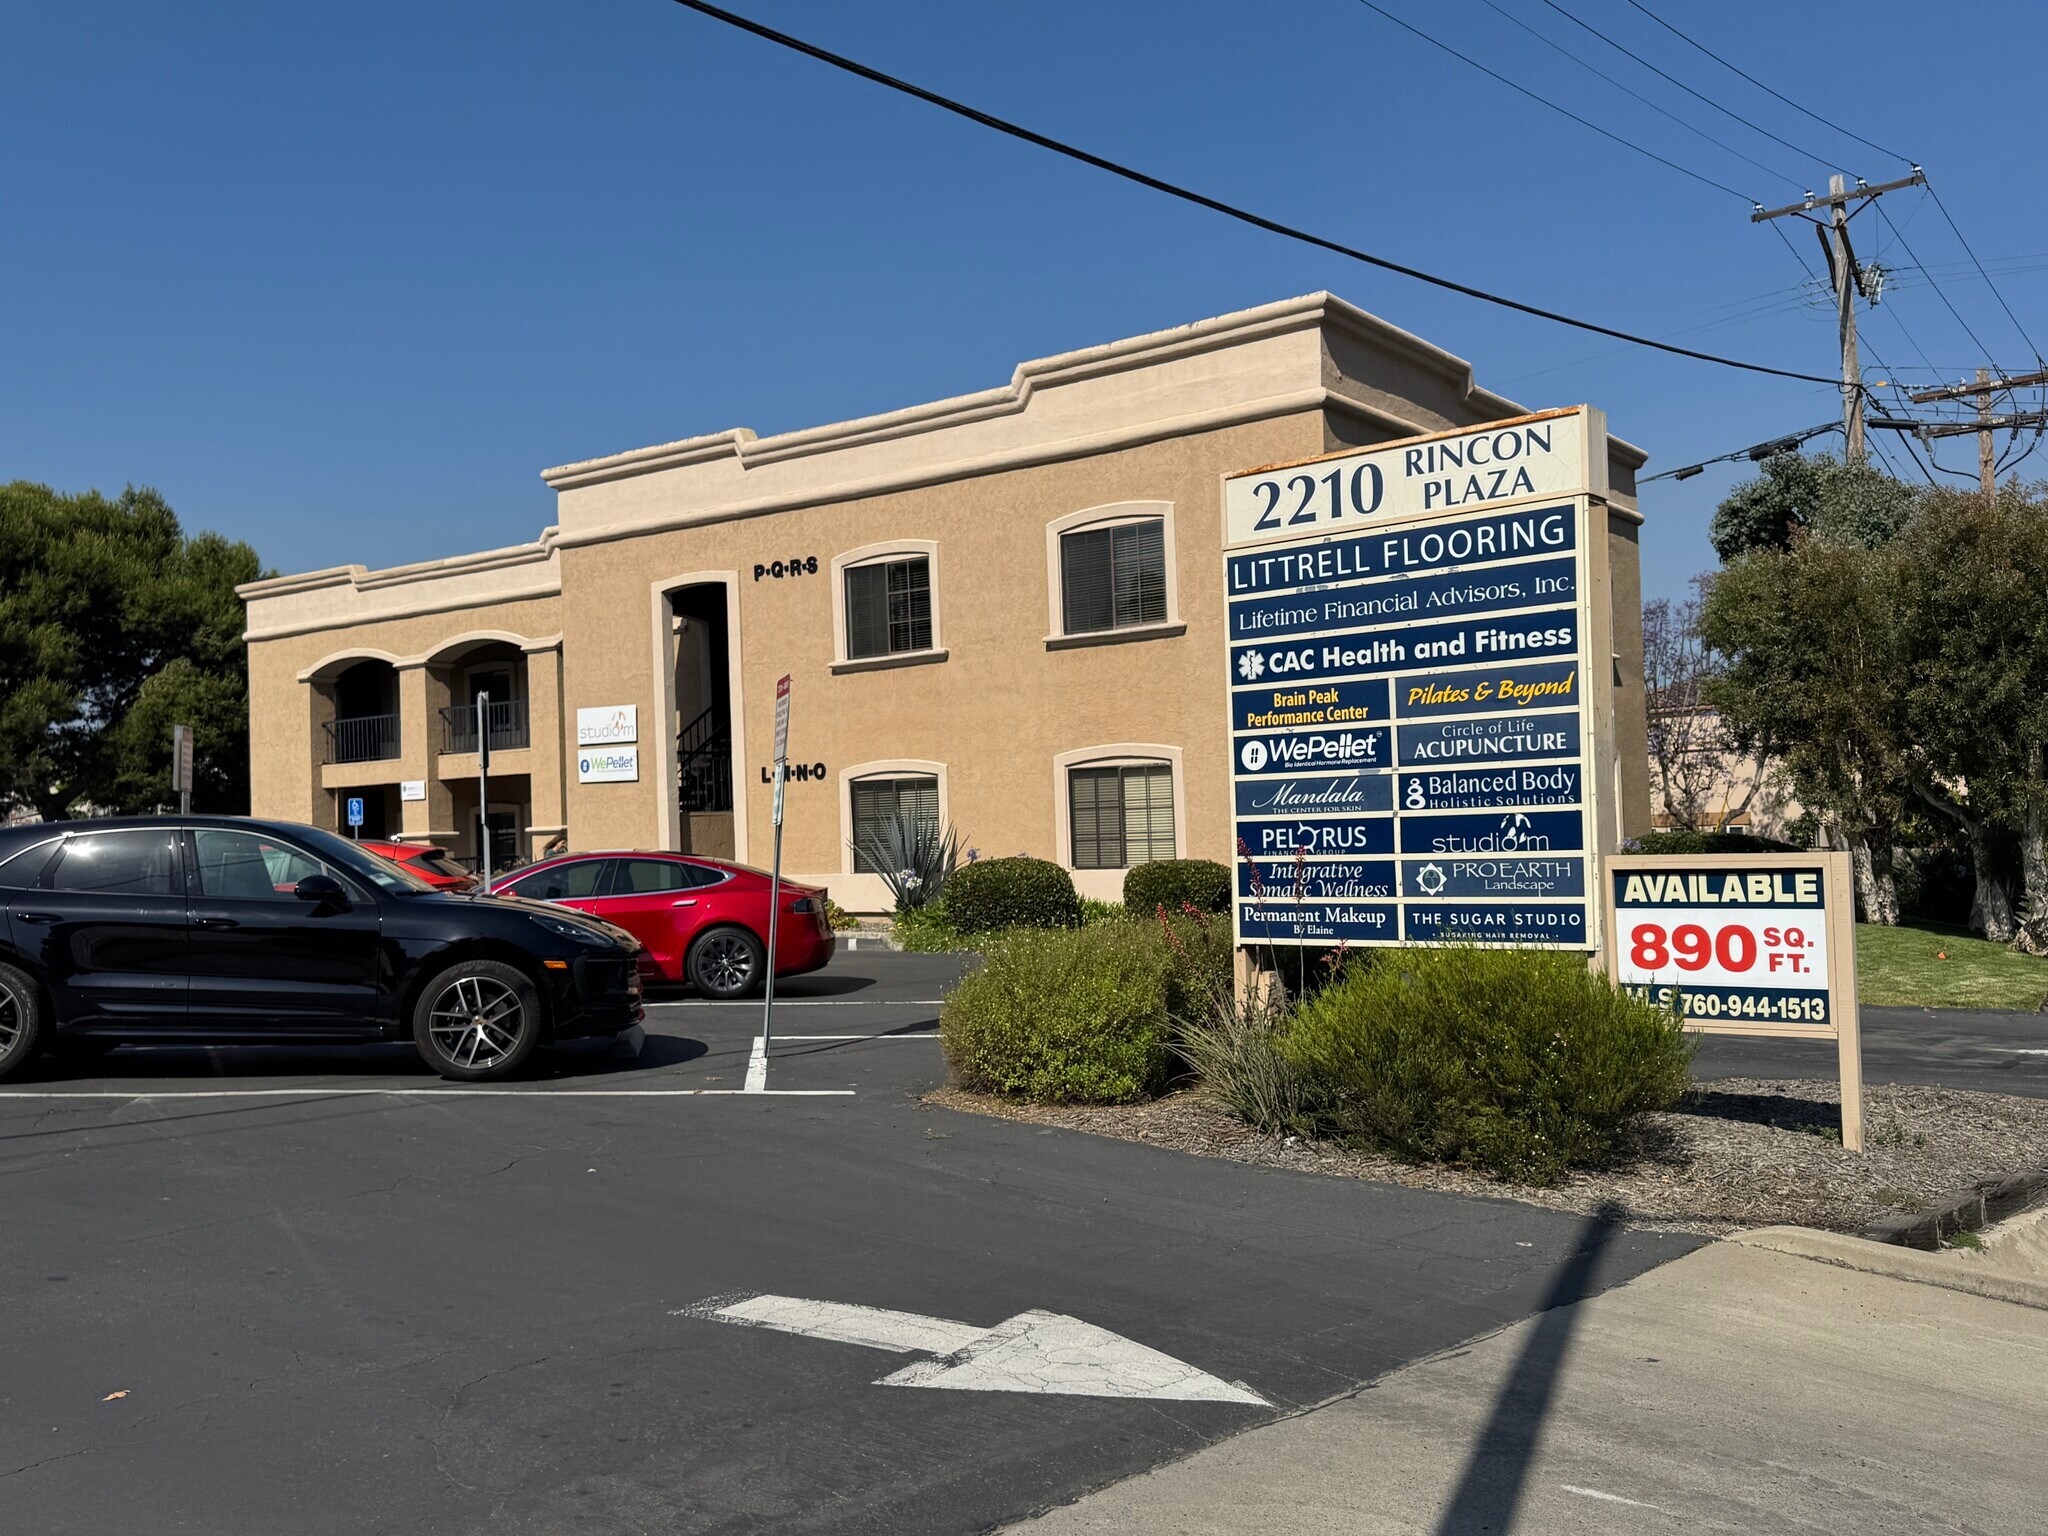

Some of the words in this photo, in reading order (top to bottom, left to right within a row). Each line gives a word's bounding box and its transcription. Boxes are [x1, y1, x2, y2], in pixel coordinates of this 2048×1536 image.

[1253, 463, 1384, 531] 2210
[1405, 424, 1551, 477] RINCON
[1424, 466, 1535, 509] PLAZA
[1234, 545, 1370, 589] LITTRELL
[1384, 515, 1565, 568] FLOORING
[1239, 607, 1317, 630] Lifetime
[1325, 591, 1418, 620] Financial
[1426, 582, 1526, 607] Advisors,
[1535, 576, 1574, 595] Inc.
[1269, 649, 1314, 673] CAC
[1323, 639, 1405, 668] Health
[1414, 632, 1465, 659] and
[1475, 627, 1572, 653] Fitness
[1274, 691, 1306, 707] Brain
[1309, 688, 1339, 704] Peak
[1408, 683, 1470, 706] Pilates
[1474, 682, 1493, 700] &
[1497, 671, 1575, 705] Beyond
[1248, 708, 1324, 727] Performance
[1326, 706, 1369, 720] Center
[1442, 723, 1483, 738] Circle
[1489, 721, 1502, 734] of
[1508, 719, 1535, 733] Life
[1414, 732, 1567, 759] ACUPUNCTURE
[591, 756, 633, 769] WePellet
[1341, 757, 1377, 765] Replacement
[1429, 770, 1517, 795] Balanced
[1523, 767, 1575, 795] Body
[1430, 796, 1491, 809] Holistic
[1496, 793, 1575, 806] Solutions
[1269, 863, 1363, 884] Integrative
[1315, 879, 1388, 897] Wellness
[1485, 875, 1555, 897] Landscape
[1623, 873, 1818, 903] AVAILABLE
[1244, 906, 1320, 923] Permanent
[1325, 907, 1386, 928] Makeup
[1413, 913, 1442, 925] THE
[1451, 913, 1506, 925] SUGAR
[1515, 913, 1581, 926] STUDIO
[1293, 924, 1305, 936] By
[1307, 924, 1334, 935] Elaine
[1764, 927, 1814, 948] SQ.
[1631, 923, 1757, 973] 890
[1769, 953, 1810, 973] FT.
[1681, 994, 1825, 1020] 760-944-1513
